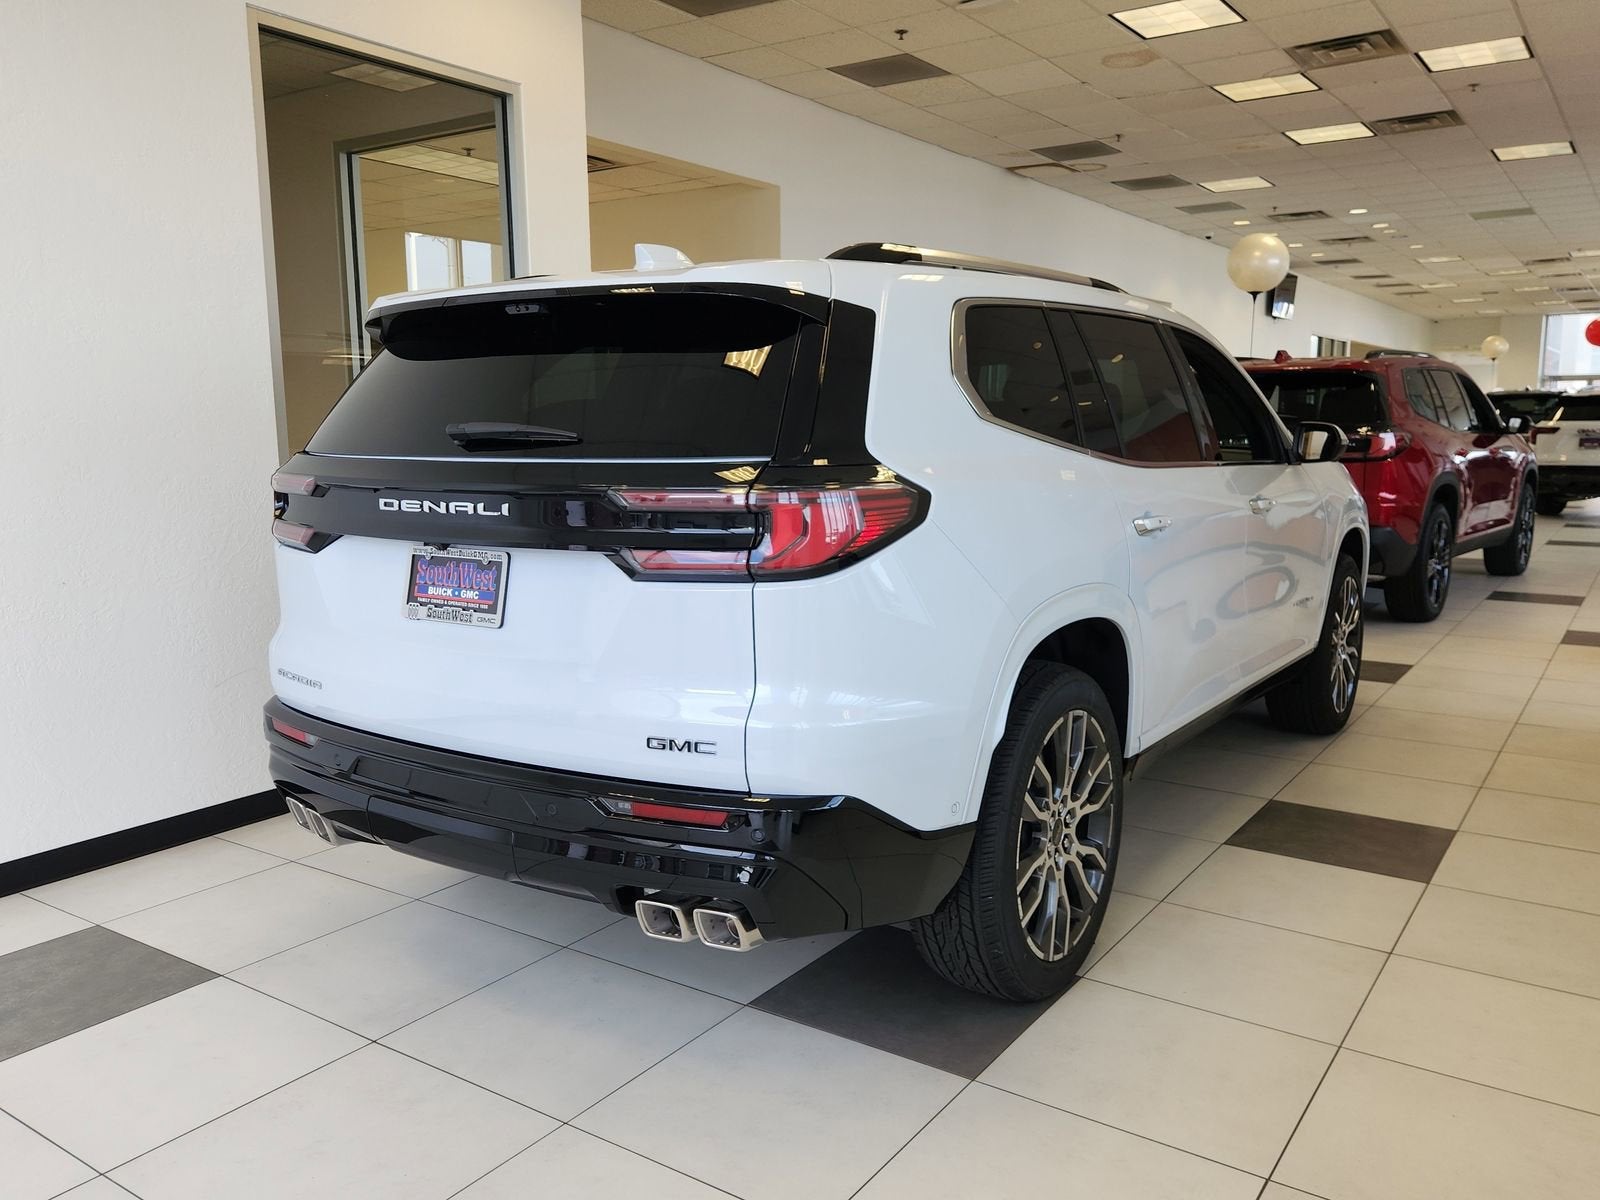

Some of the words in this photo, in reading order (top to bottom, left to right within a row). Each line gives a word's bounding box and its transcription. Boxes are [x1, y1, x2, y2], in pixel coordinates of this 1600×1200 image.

[378, 498, 510, 516] DENALI
[416, 558, 498, 591] SouthWest
[428, 586, 453, 597] BUICK
[460, 590, 480, 599] GMC
[426, 605, 473, 623] SouthWest
[476, 616, 496, 624] GMC
[646, 737, 716, 755] GMC
